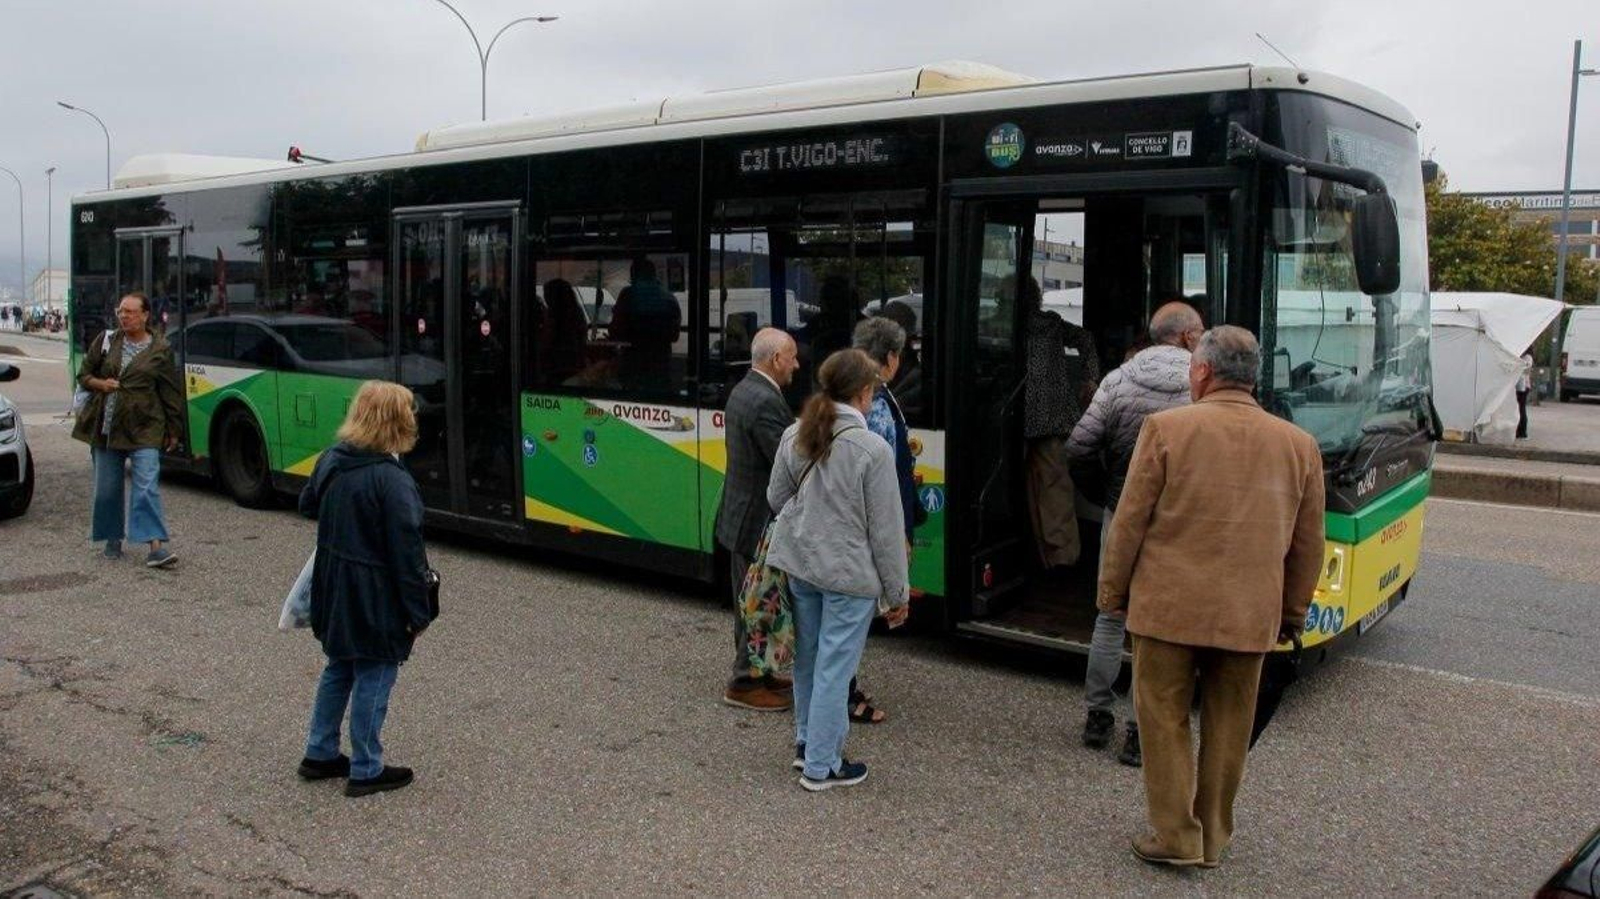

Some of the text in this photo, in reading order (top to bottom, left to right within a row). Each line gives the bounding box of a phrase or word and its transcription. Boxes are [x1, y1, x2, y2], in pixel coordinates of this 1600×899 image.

[1128, 137, 1168, 146] CONCELLO
[1132, 144, 1163, 154] DE VIGO
[526, 396, 561, 410] SAIDA
[612, 404, 672, 422] avanza
